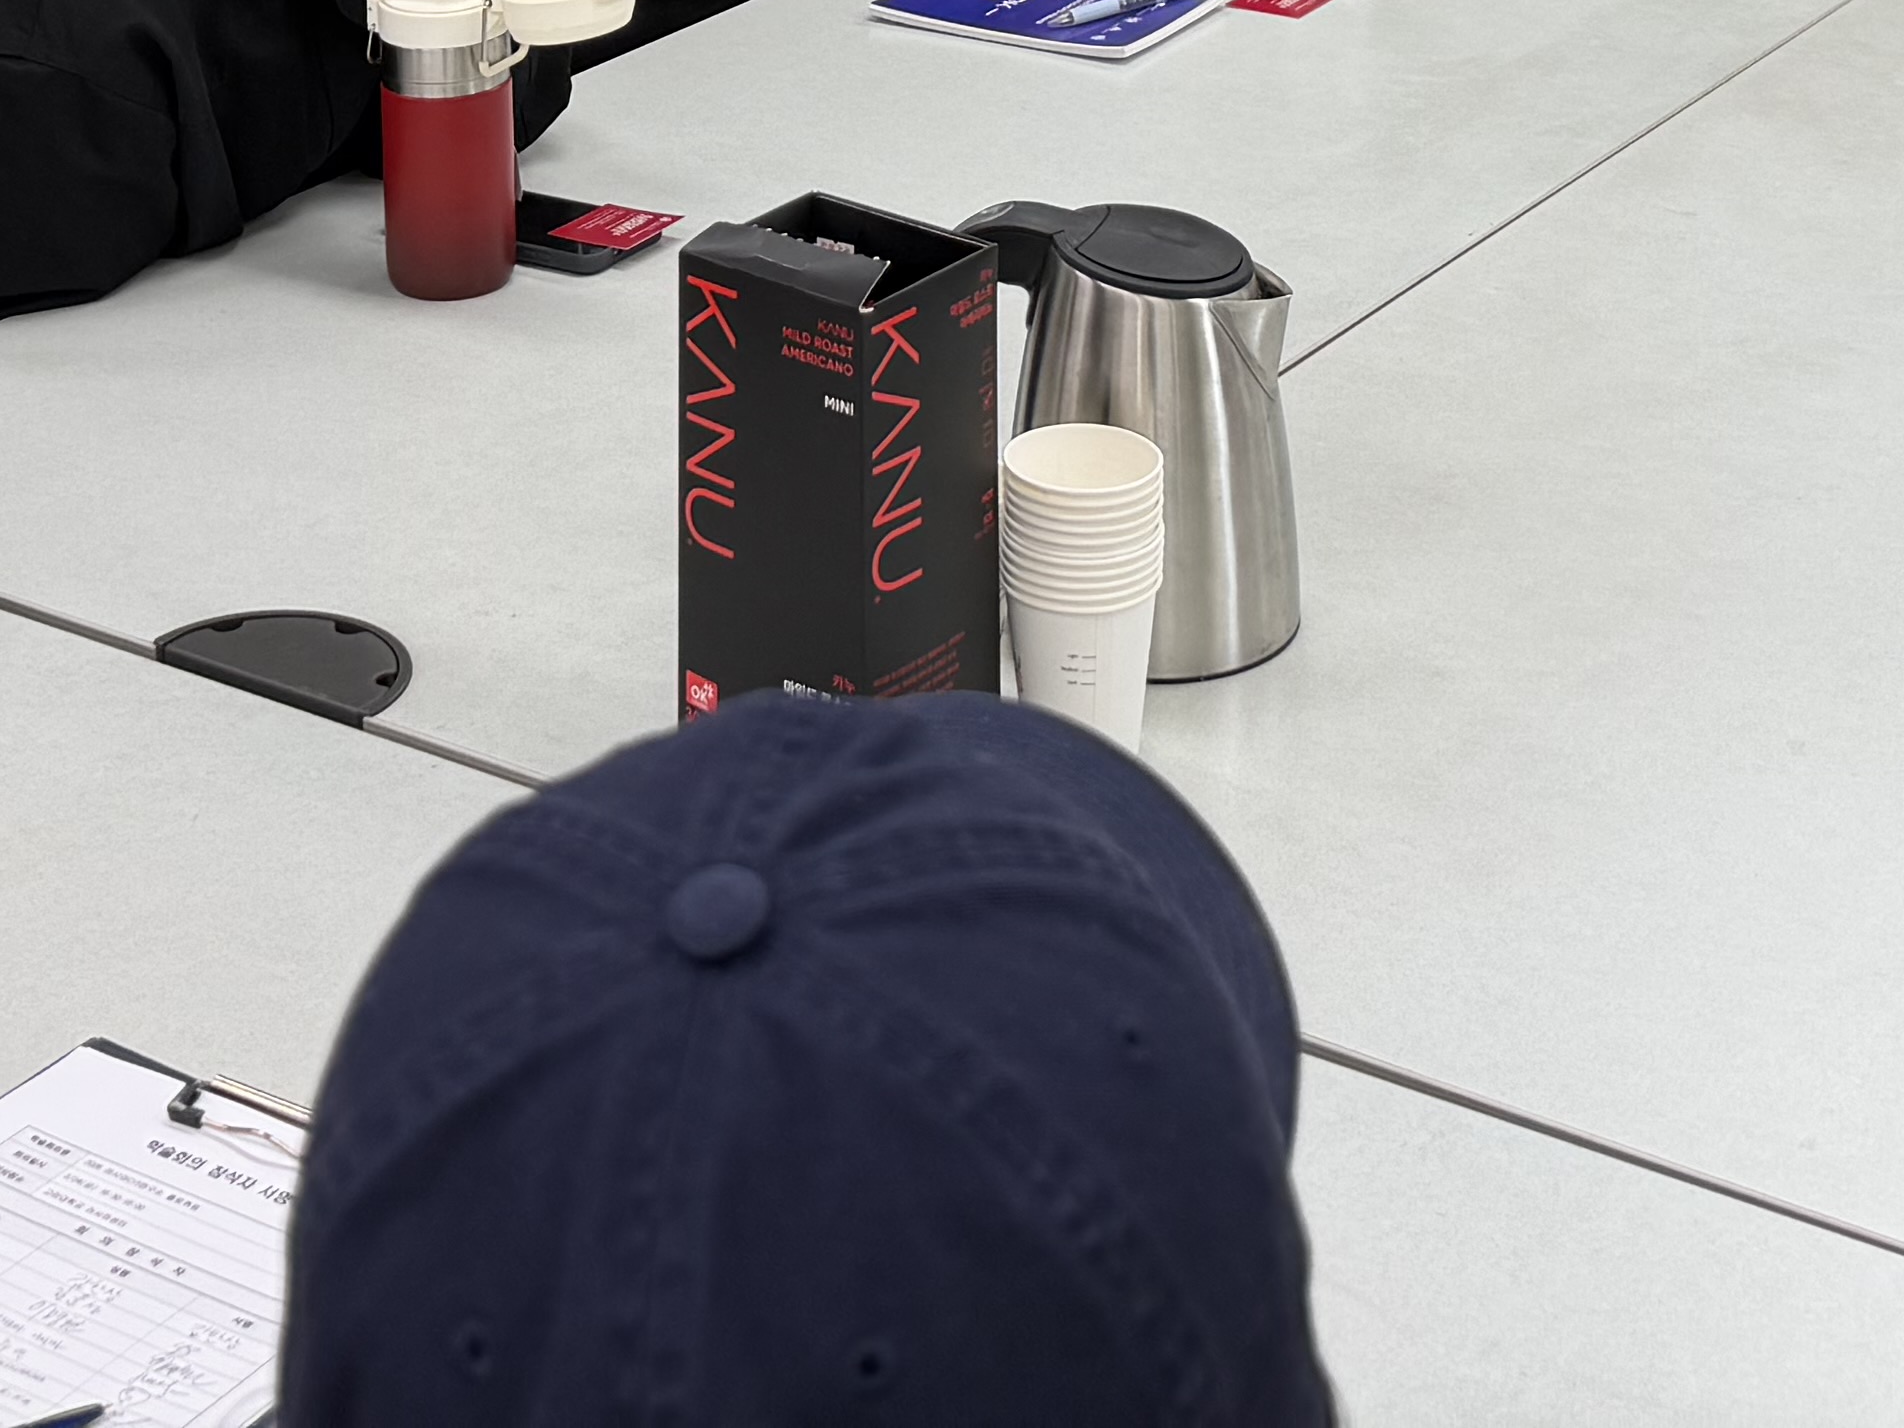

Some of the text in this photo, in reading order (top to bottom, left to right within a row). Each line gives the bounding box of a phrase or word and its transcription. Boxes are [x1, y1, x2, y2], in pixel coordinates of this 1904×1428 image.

[781, 325, 854, 359] MILD ROAST
[817, 317, 855, 342] KANU
[780, 343, 855, 378] AMERICANO
[684, 274, 739, 560] KANU
[823, 394, 855, 417] MINI
[870, 305, 924, 593] KANU
[145, 1138, 207, 1172] 학술회의
